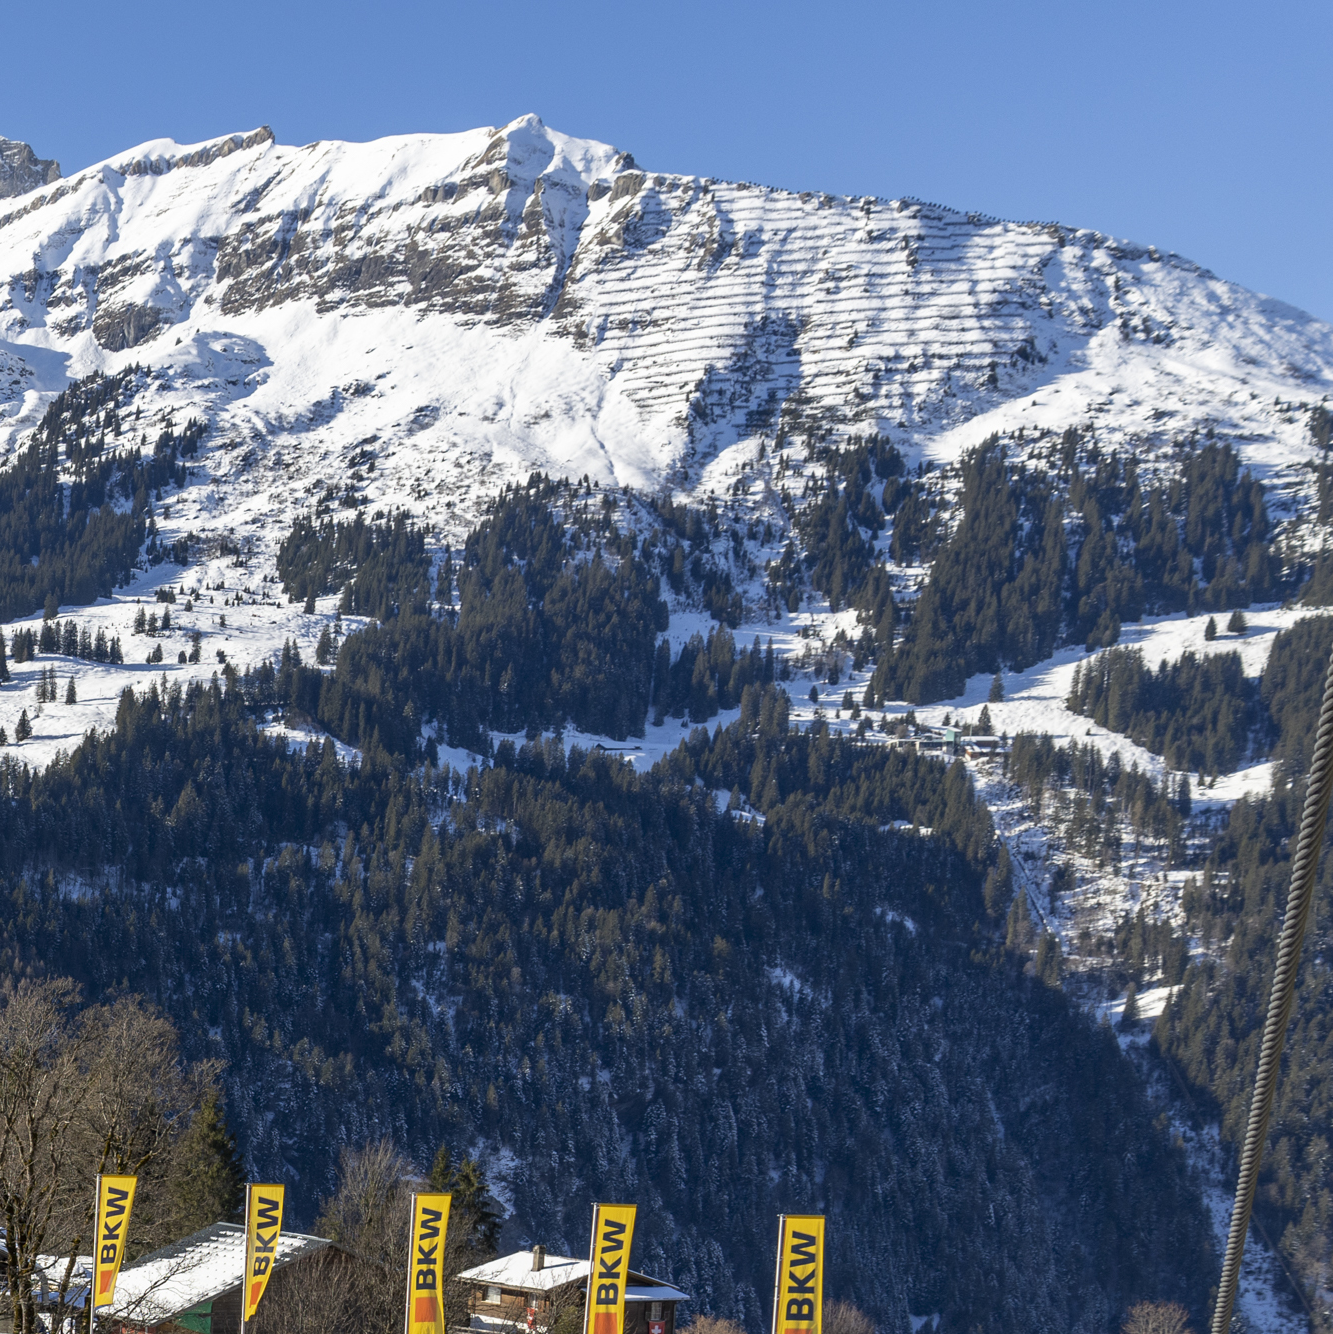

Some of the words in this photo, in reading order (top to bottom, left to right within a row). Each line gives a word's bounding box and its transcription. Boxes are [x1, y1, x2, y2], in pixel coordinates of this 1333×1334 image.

[100, 1186, 129, 1264] BKW
[253, 1196, 279, 1276] BKW
[415, 1207, 443, 1290] BKW
[596, 1219, 626, 1306] BKW
[786, 1230, 816, 1321] BKW
